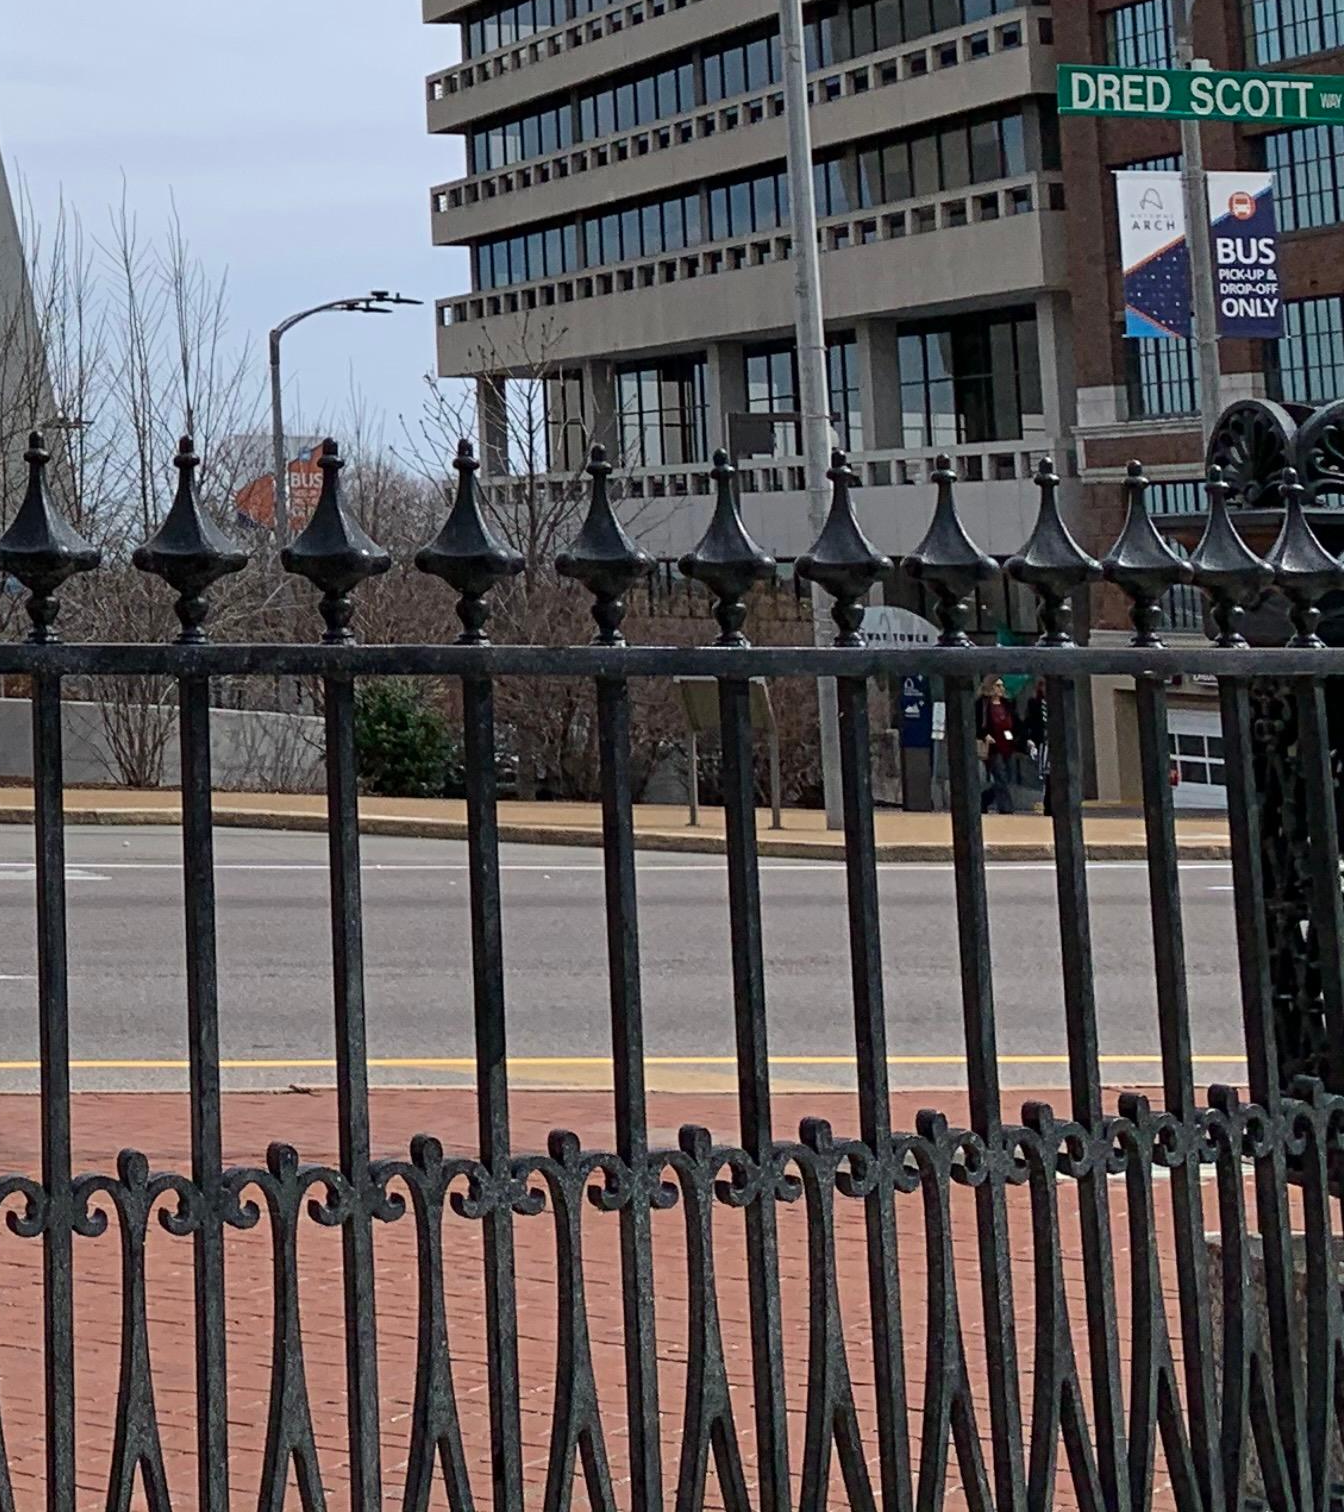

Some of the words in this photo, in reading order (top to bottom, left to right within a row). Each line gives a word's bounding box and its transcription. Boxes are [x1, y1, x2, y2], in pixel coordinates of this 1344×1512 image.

[1070, 71, 1172, 113] DRED
[1189, 76, 1314, 119] SCOTT
[1319, 92, 1342, 109] WAY
[1131, 219, 1176, 231] ARCH
[1215, 237, 1277, 265] BUS
[1218, 268, 1265, 281] PICK-UP
[1266, 268, 1279, 281] &
[1219, 282, 1280, 295] DROP-OFF
[1220, 297, 1279, 318] ONLY
[291, 471, 323, 488] BUS
